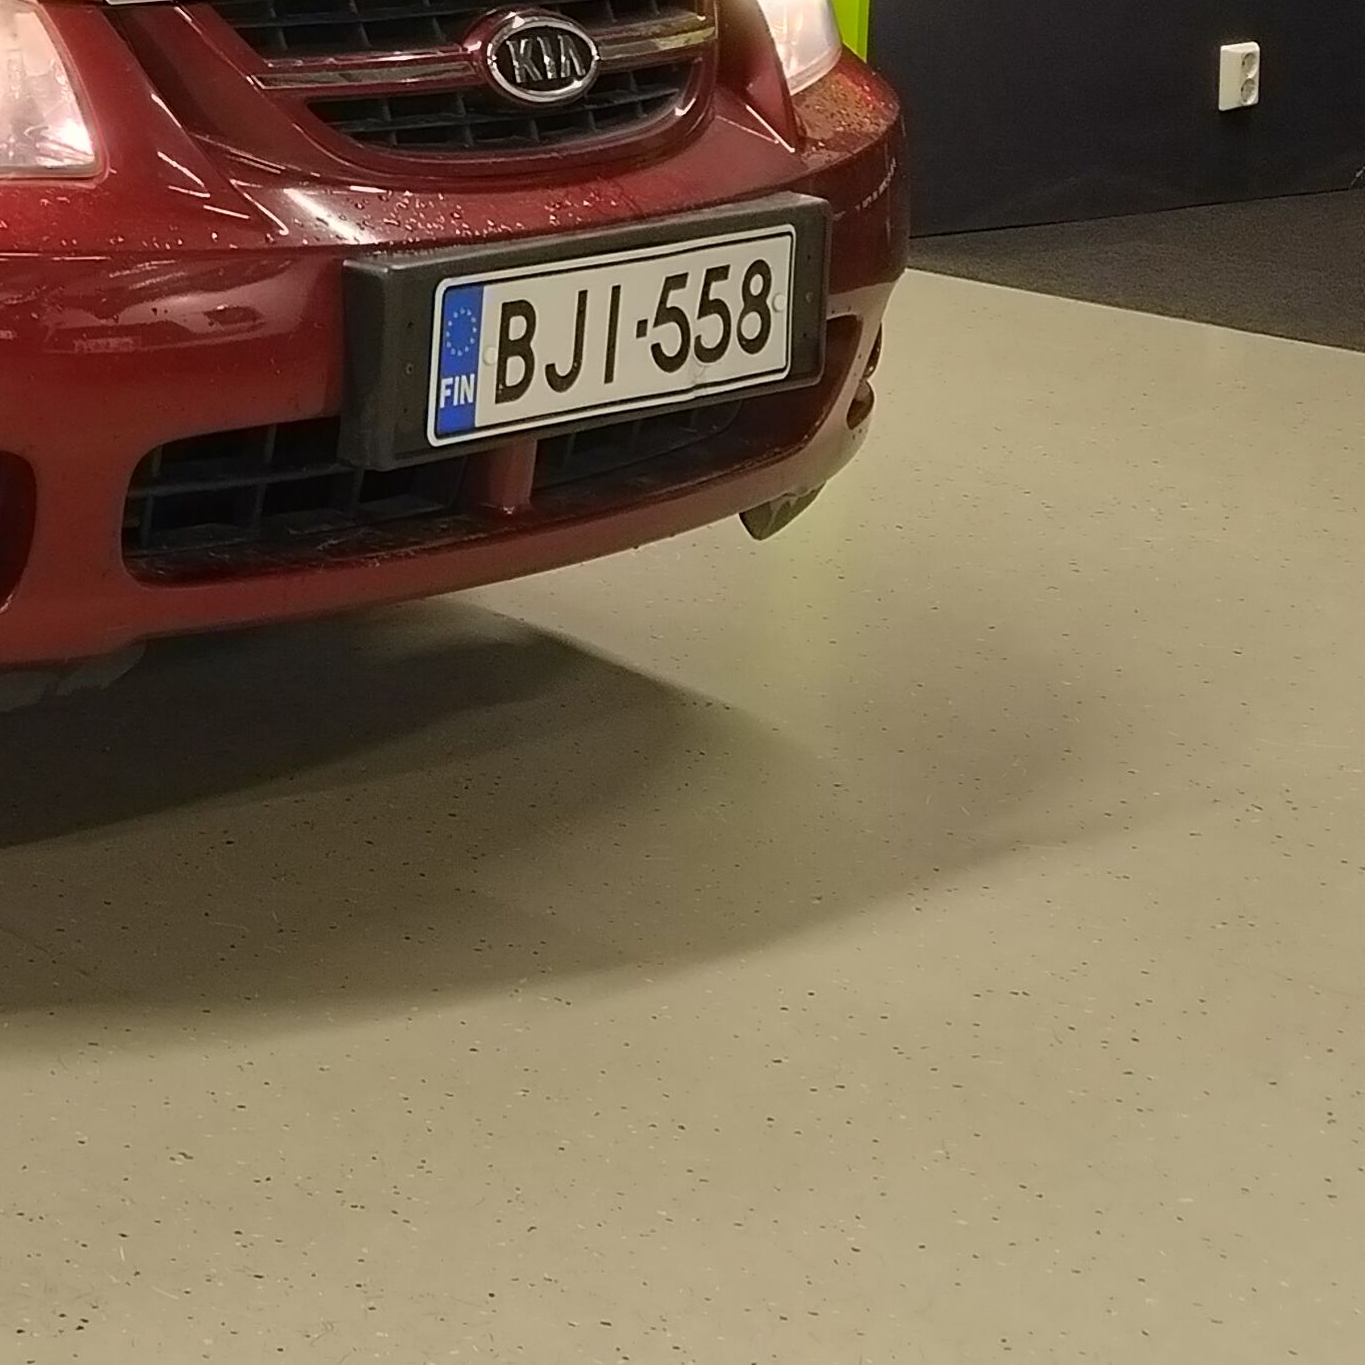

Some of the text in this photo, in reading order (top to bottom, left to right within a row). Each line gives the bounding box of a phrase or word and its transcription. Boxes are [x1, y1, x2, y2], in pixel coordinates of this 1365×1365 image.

[505, 34, 587, 84] KIA
[494, 258, 773, 405] BJI-558
[439, 372, 476, 409] FIN
